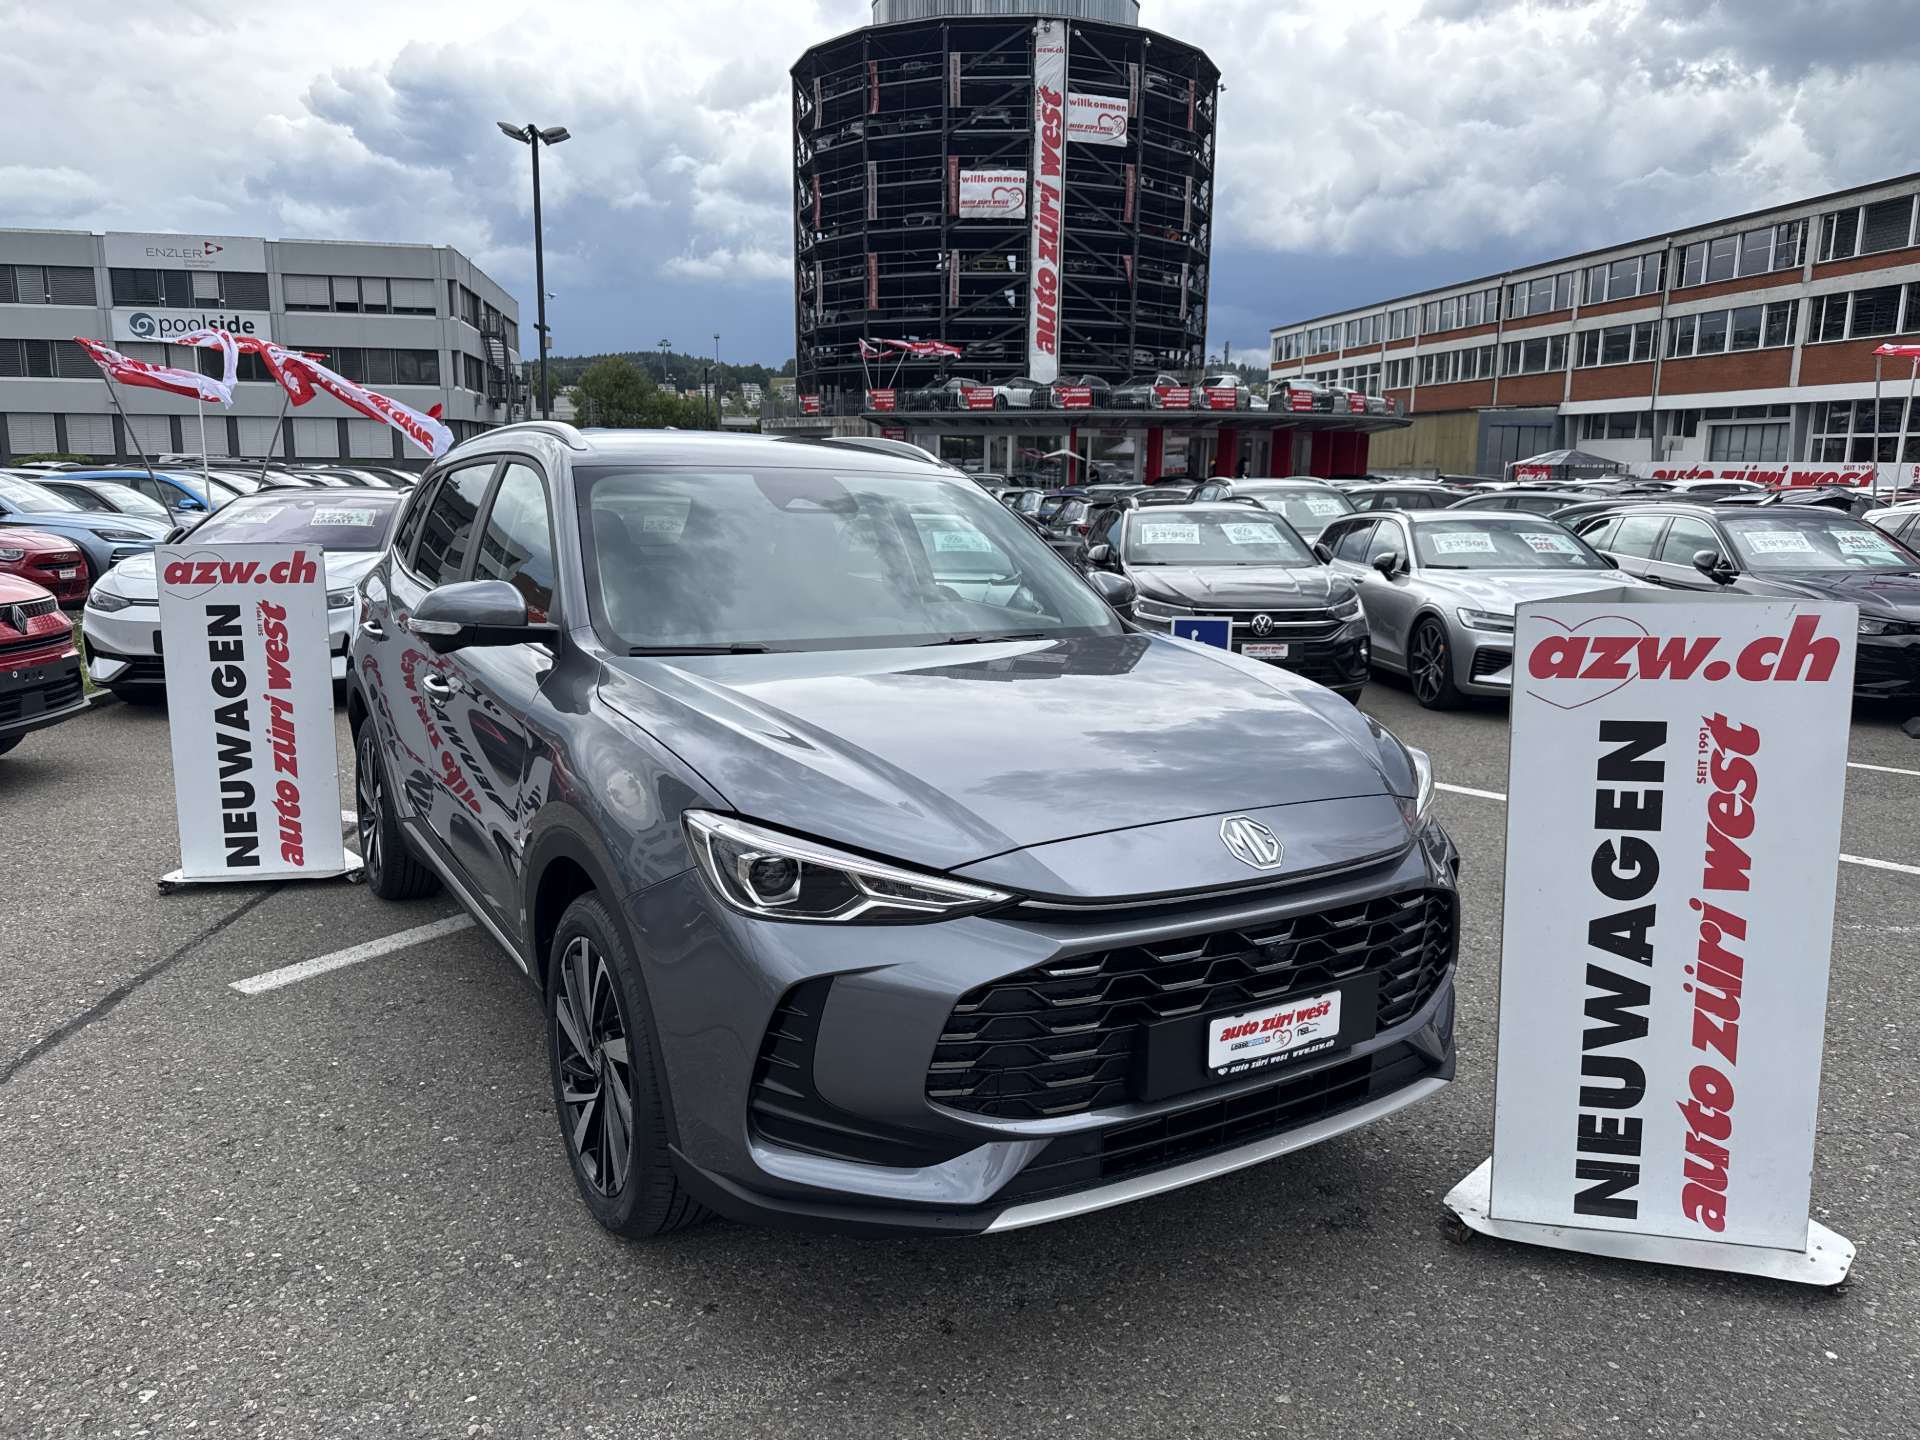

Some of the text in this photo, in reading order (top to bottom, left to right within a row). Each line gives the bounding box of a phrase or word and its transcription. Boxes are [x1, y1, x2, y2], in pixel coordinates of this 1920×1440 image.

[1068, 98, 1127, 112] willkommen
[961, 175, 1025, 184] willkommen
[1033, 85, 1062, 356] auto züri west
[145, 247, 203, 259] ENZLER
[158, 314, 255, 338] poolside
[164, 551, 317, 585] azw.ch
[1528, 615, 1841, 682] azw.ch
[205, 604, 260, 867] NEUWAGEN
[257, 600, 304, 866] auto züri west
[1697, 727, 1710, 785] SEIT 1991
[1226, 820, 1279, 862] MG
[1573, 719, 1668, 1220] NEUWAGEN
[1676, 712, 1761, 1233] auto züri west
[1220, 1020, 1259, 1042] auto
[1259, 1009, 1296, 1033] züri
[1296, 1001, 1332, 1022] west
[1230, 1063, 1249, 1074] auto
[1271, 1053, 1289, 1065] west
